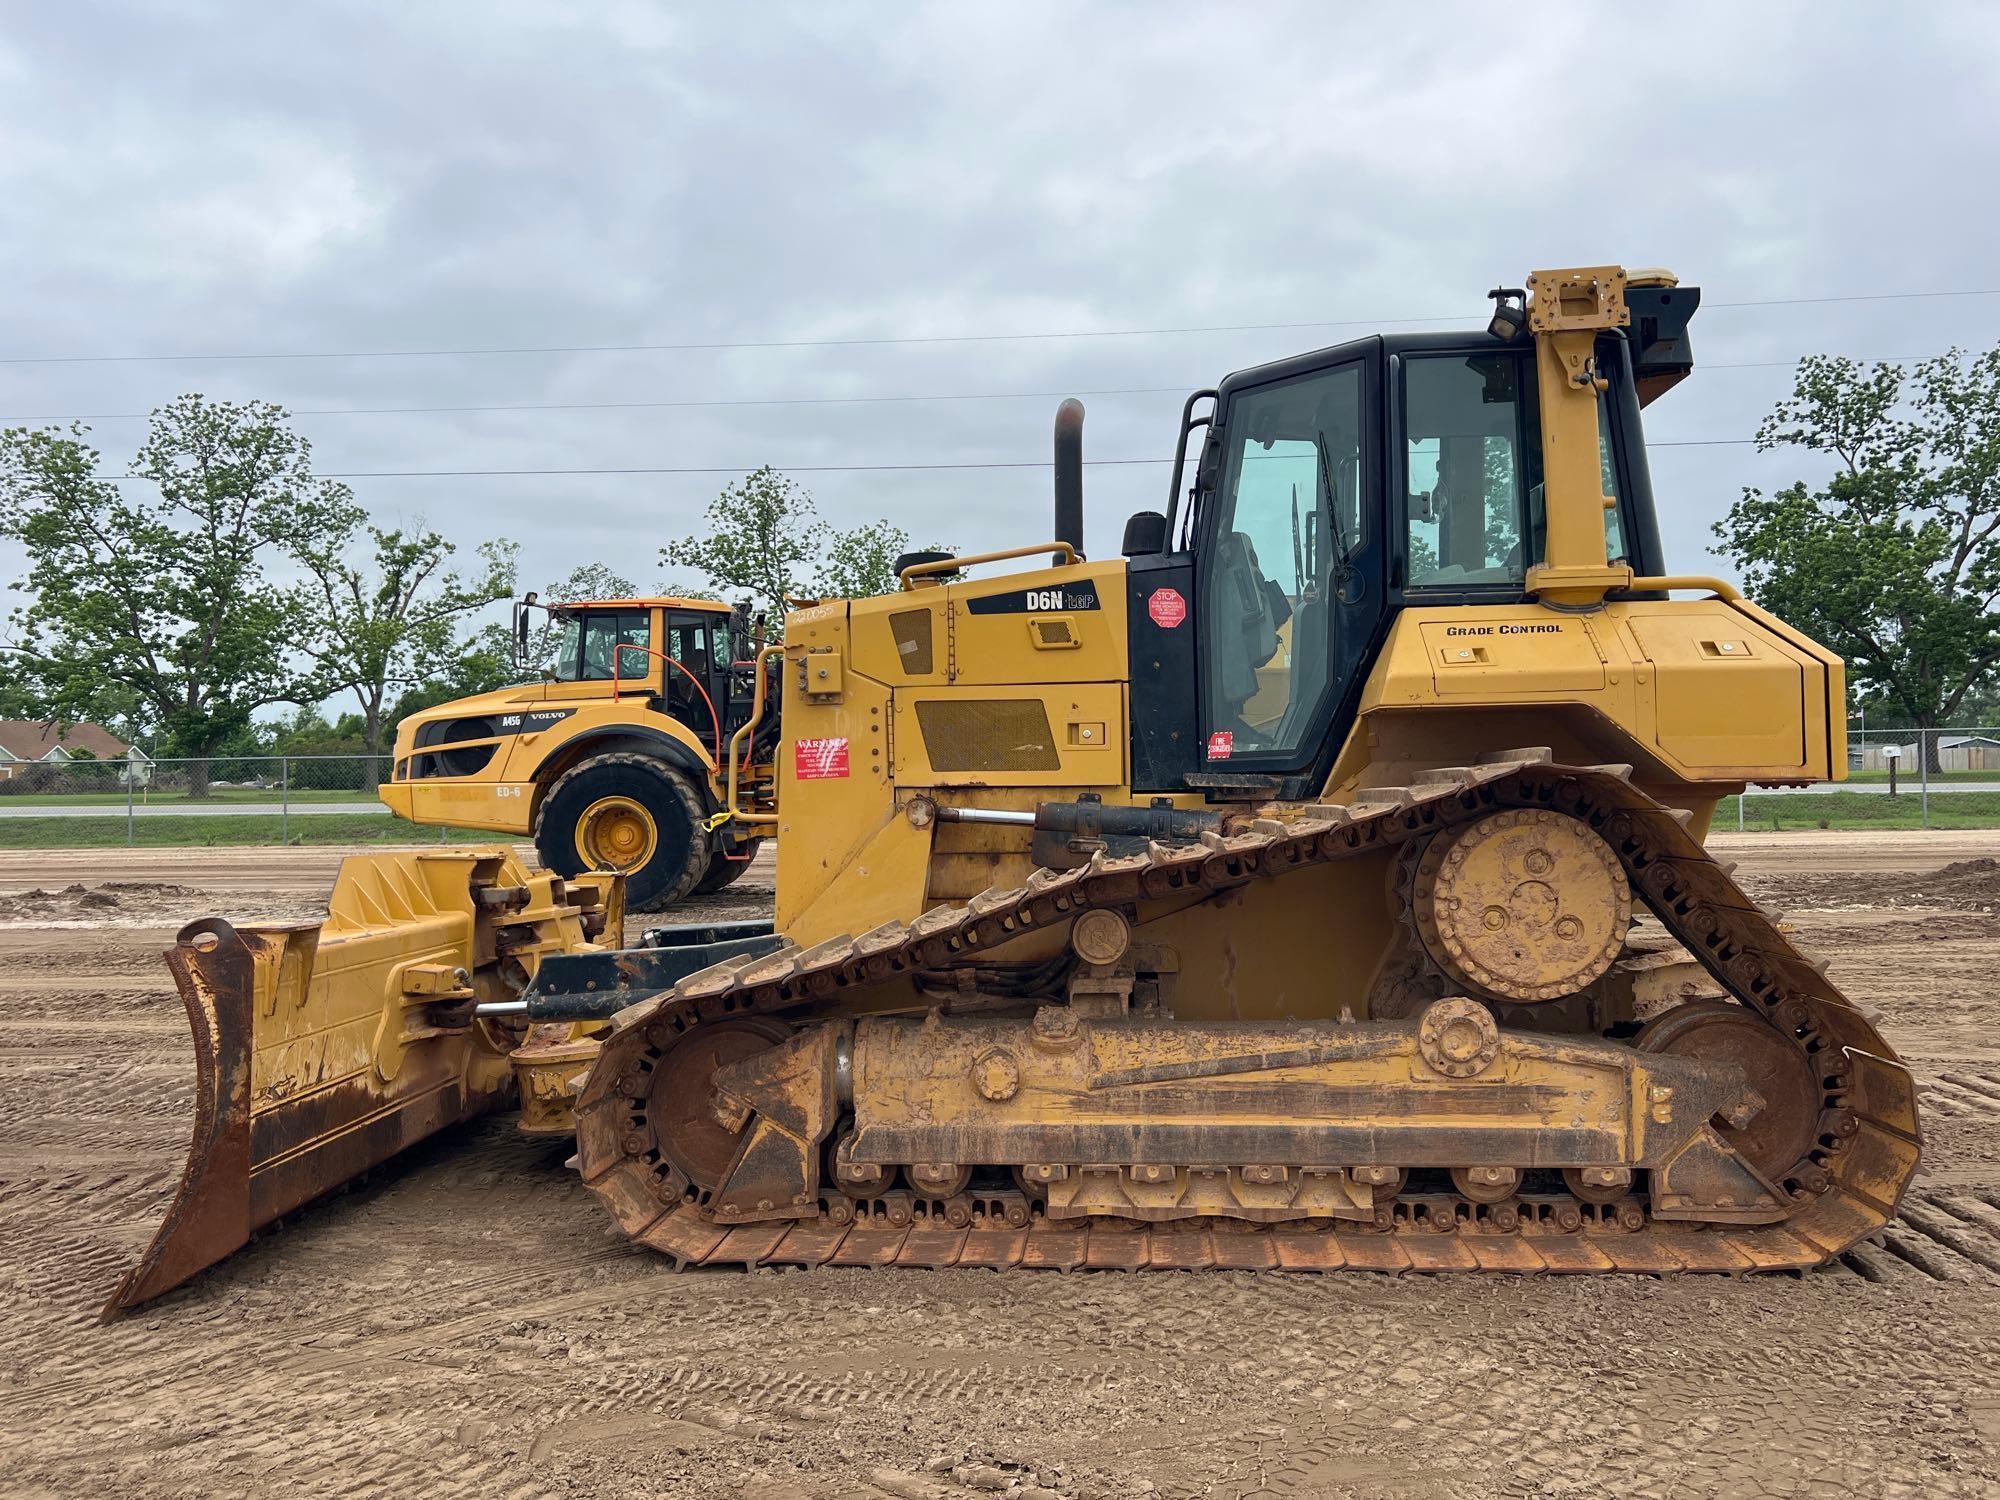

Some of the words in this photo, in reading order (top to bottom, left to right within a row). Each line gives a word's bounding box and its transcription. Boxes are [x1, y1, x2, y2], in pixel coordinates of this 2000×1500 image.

[1026, 590, 1063, 610] D6N
[1068, 594, 1094, 609] LGP
[1156, 591, 1177, 601] STOP
[1446, 626, 1494, 636] GRADE
[1499, 625, 1563, 635] CONTROL
[502, 715, 520, 727] A45G
[530, 711, 566, 720] VOLVO
[496, 786, 521, 797] ED-6
